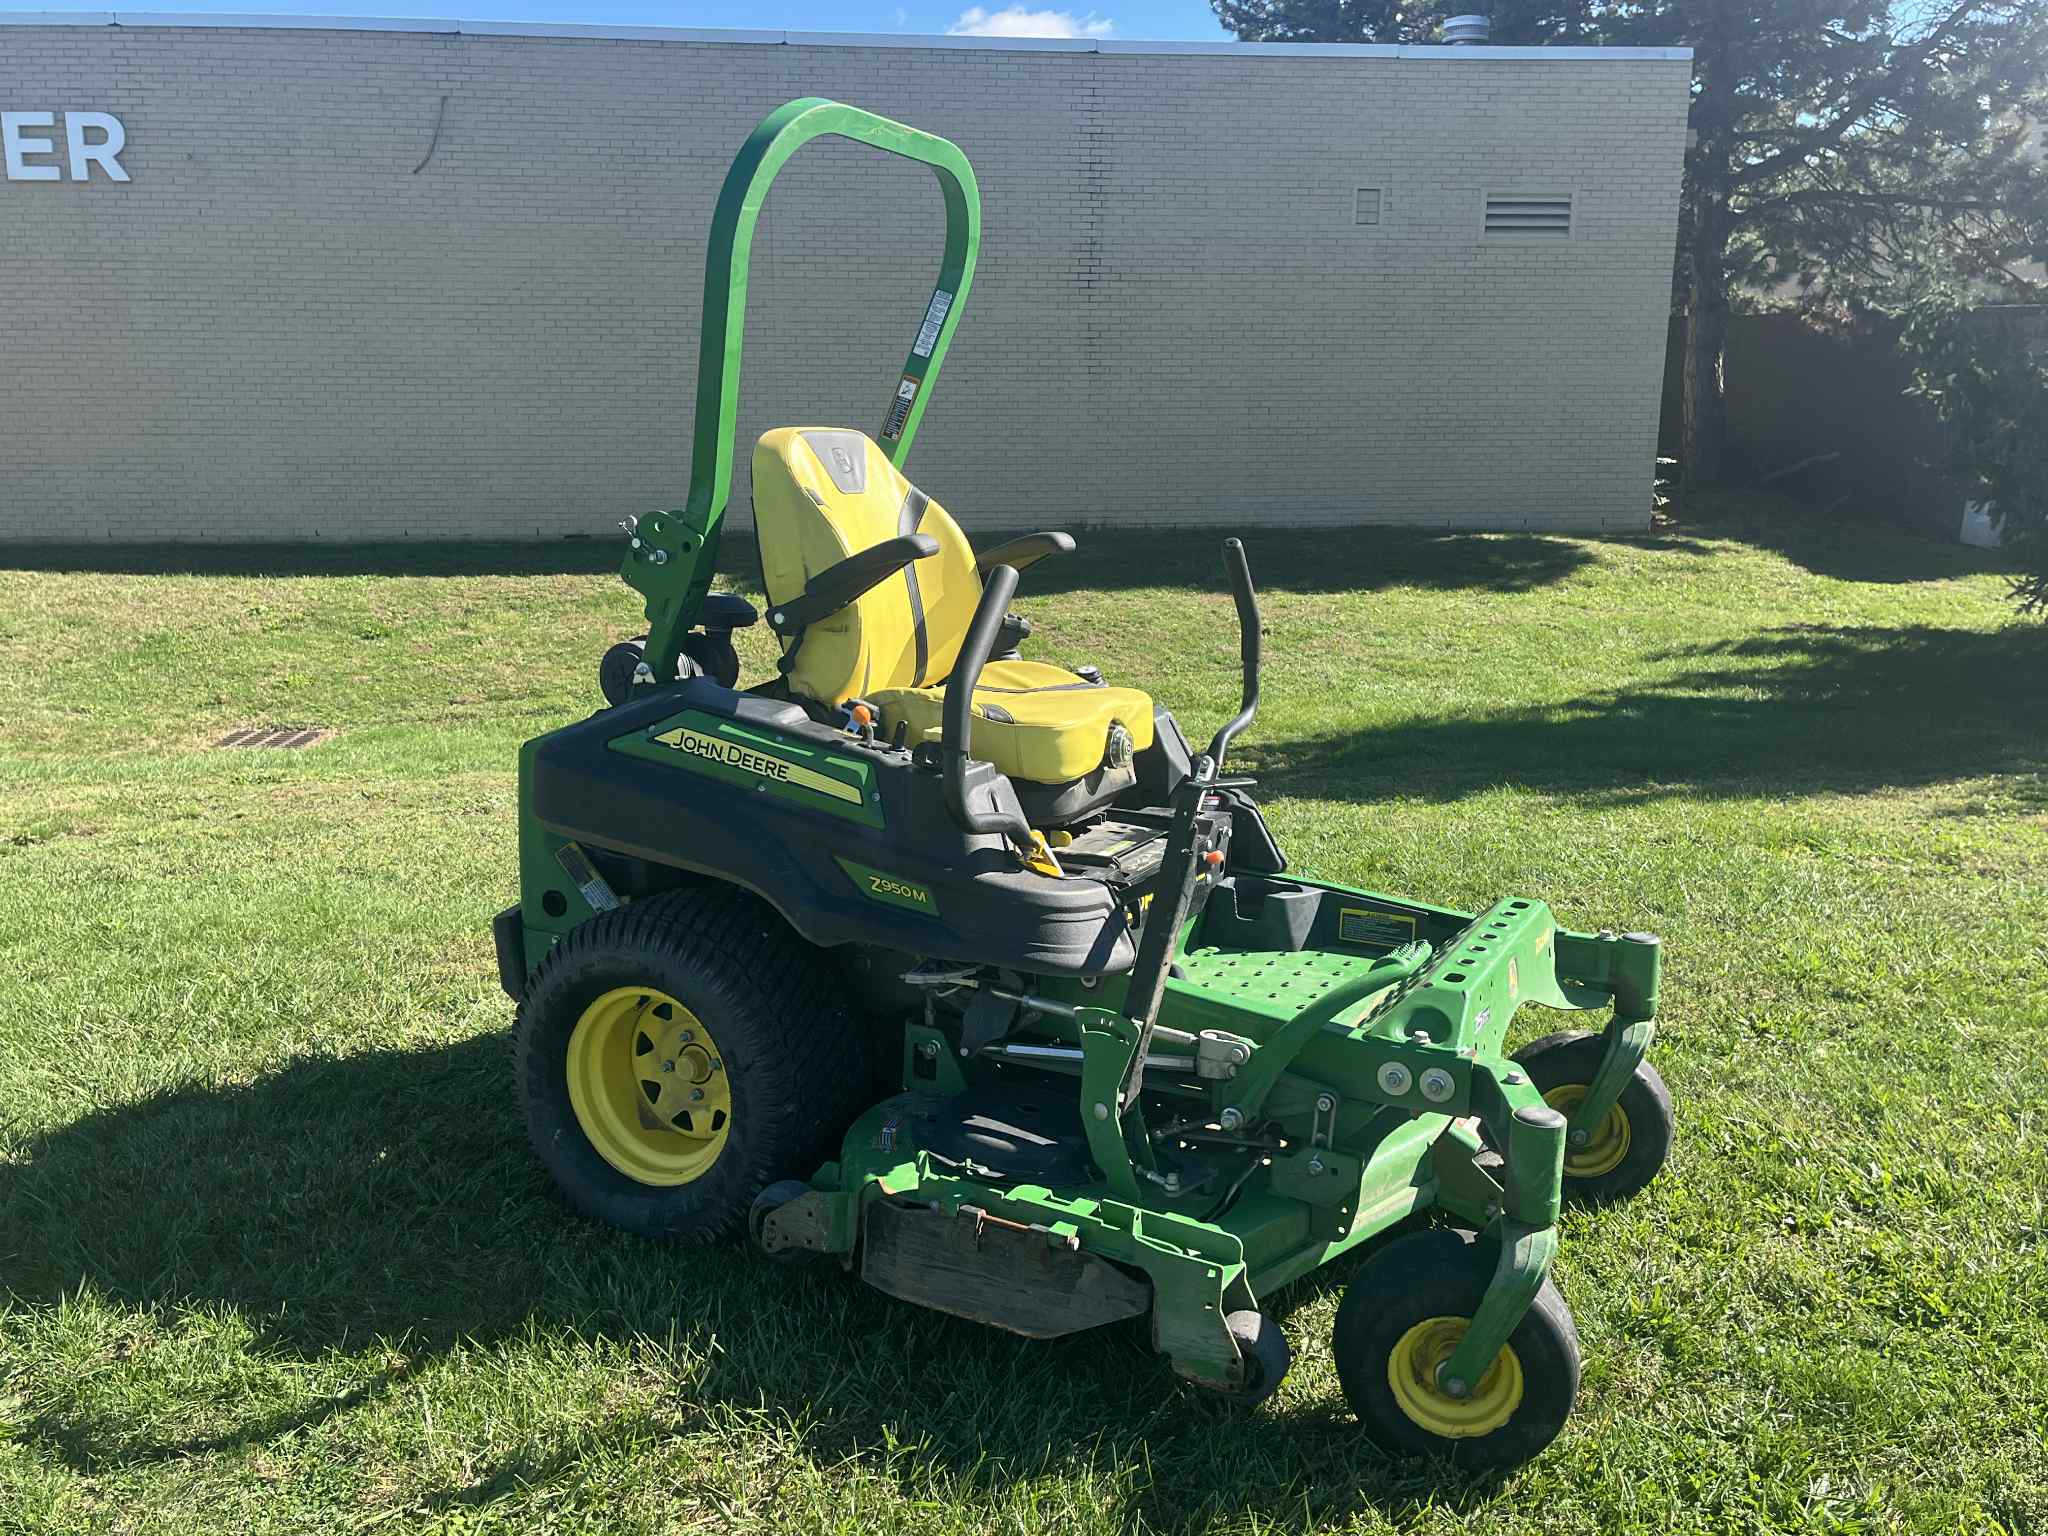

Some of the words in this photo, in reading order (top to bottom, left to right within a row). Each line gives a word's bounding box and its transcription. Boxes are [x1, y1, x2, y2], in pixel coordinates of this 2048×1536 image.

[672, 730, 724, 761] JOHN
[726, 745, 790, 779] DEERE
[869, 875, 927, 903] Z950M
